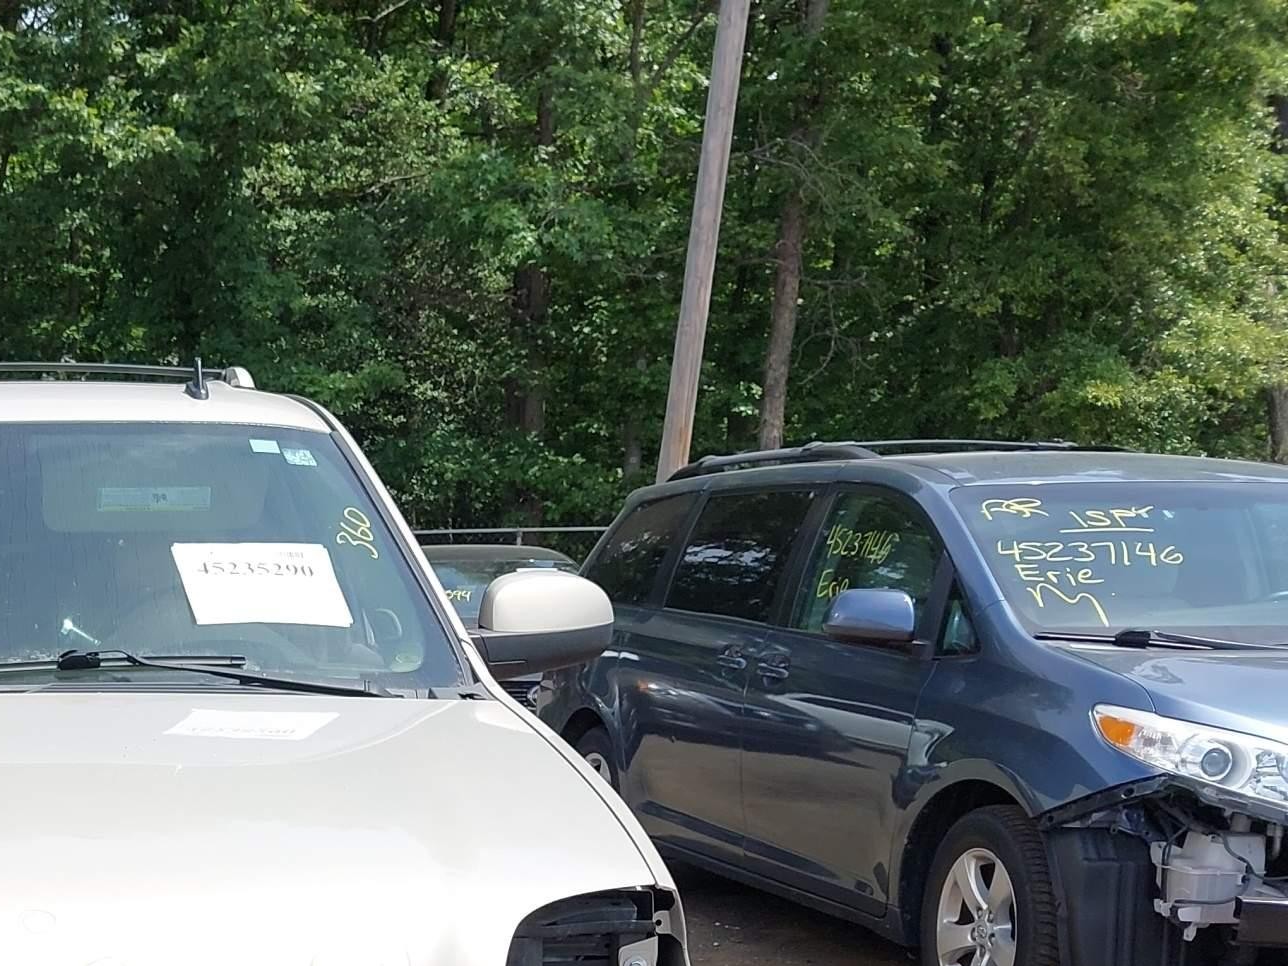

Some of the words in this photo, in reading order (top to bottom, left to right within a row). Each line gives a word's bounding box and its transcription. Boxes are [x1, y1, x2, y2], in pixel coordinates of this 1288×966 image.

[997, 540, 1184, 567] 45237146
[197, 560, 315, 577] 45235290
[1014, 563, 1105, 587] Erie
